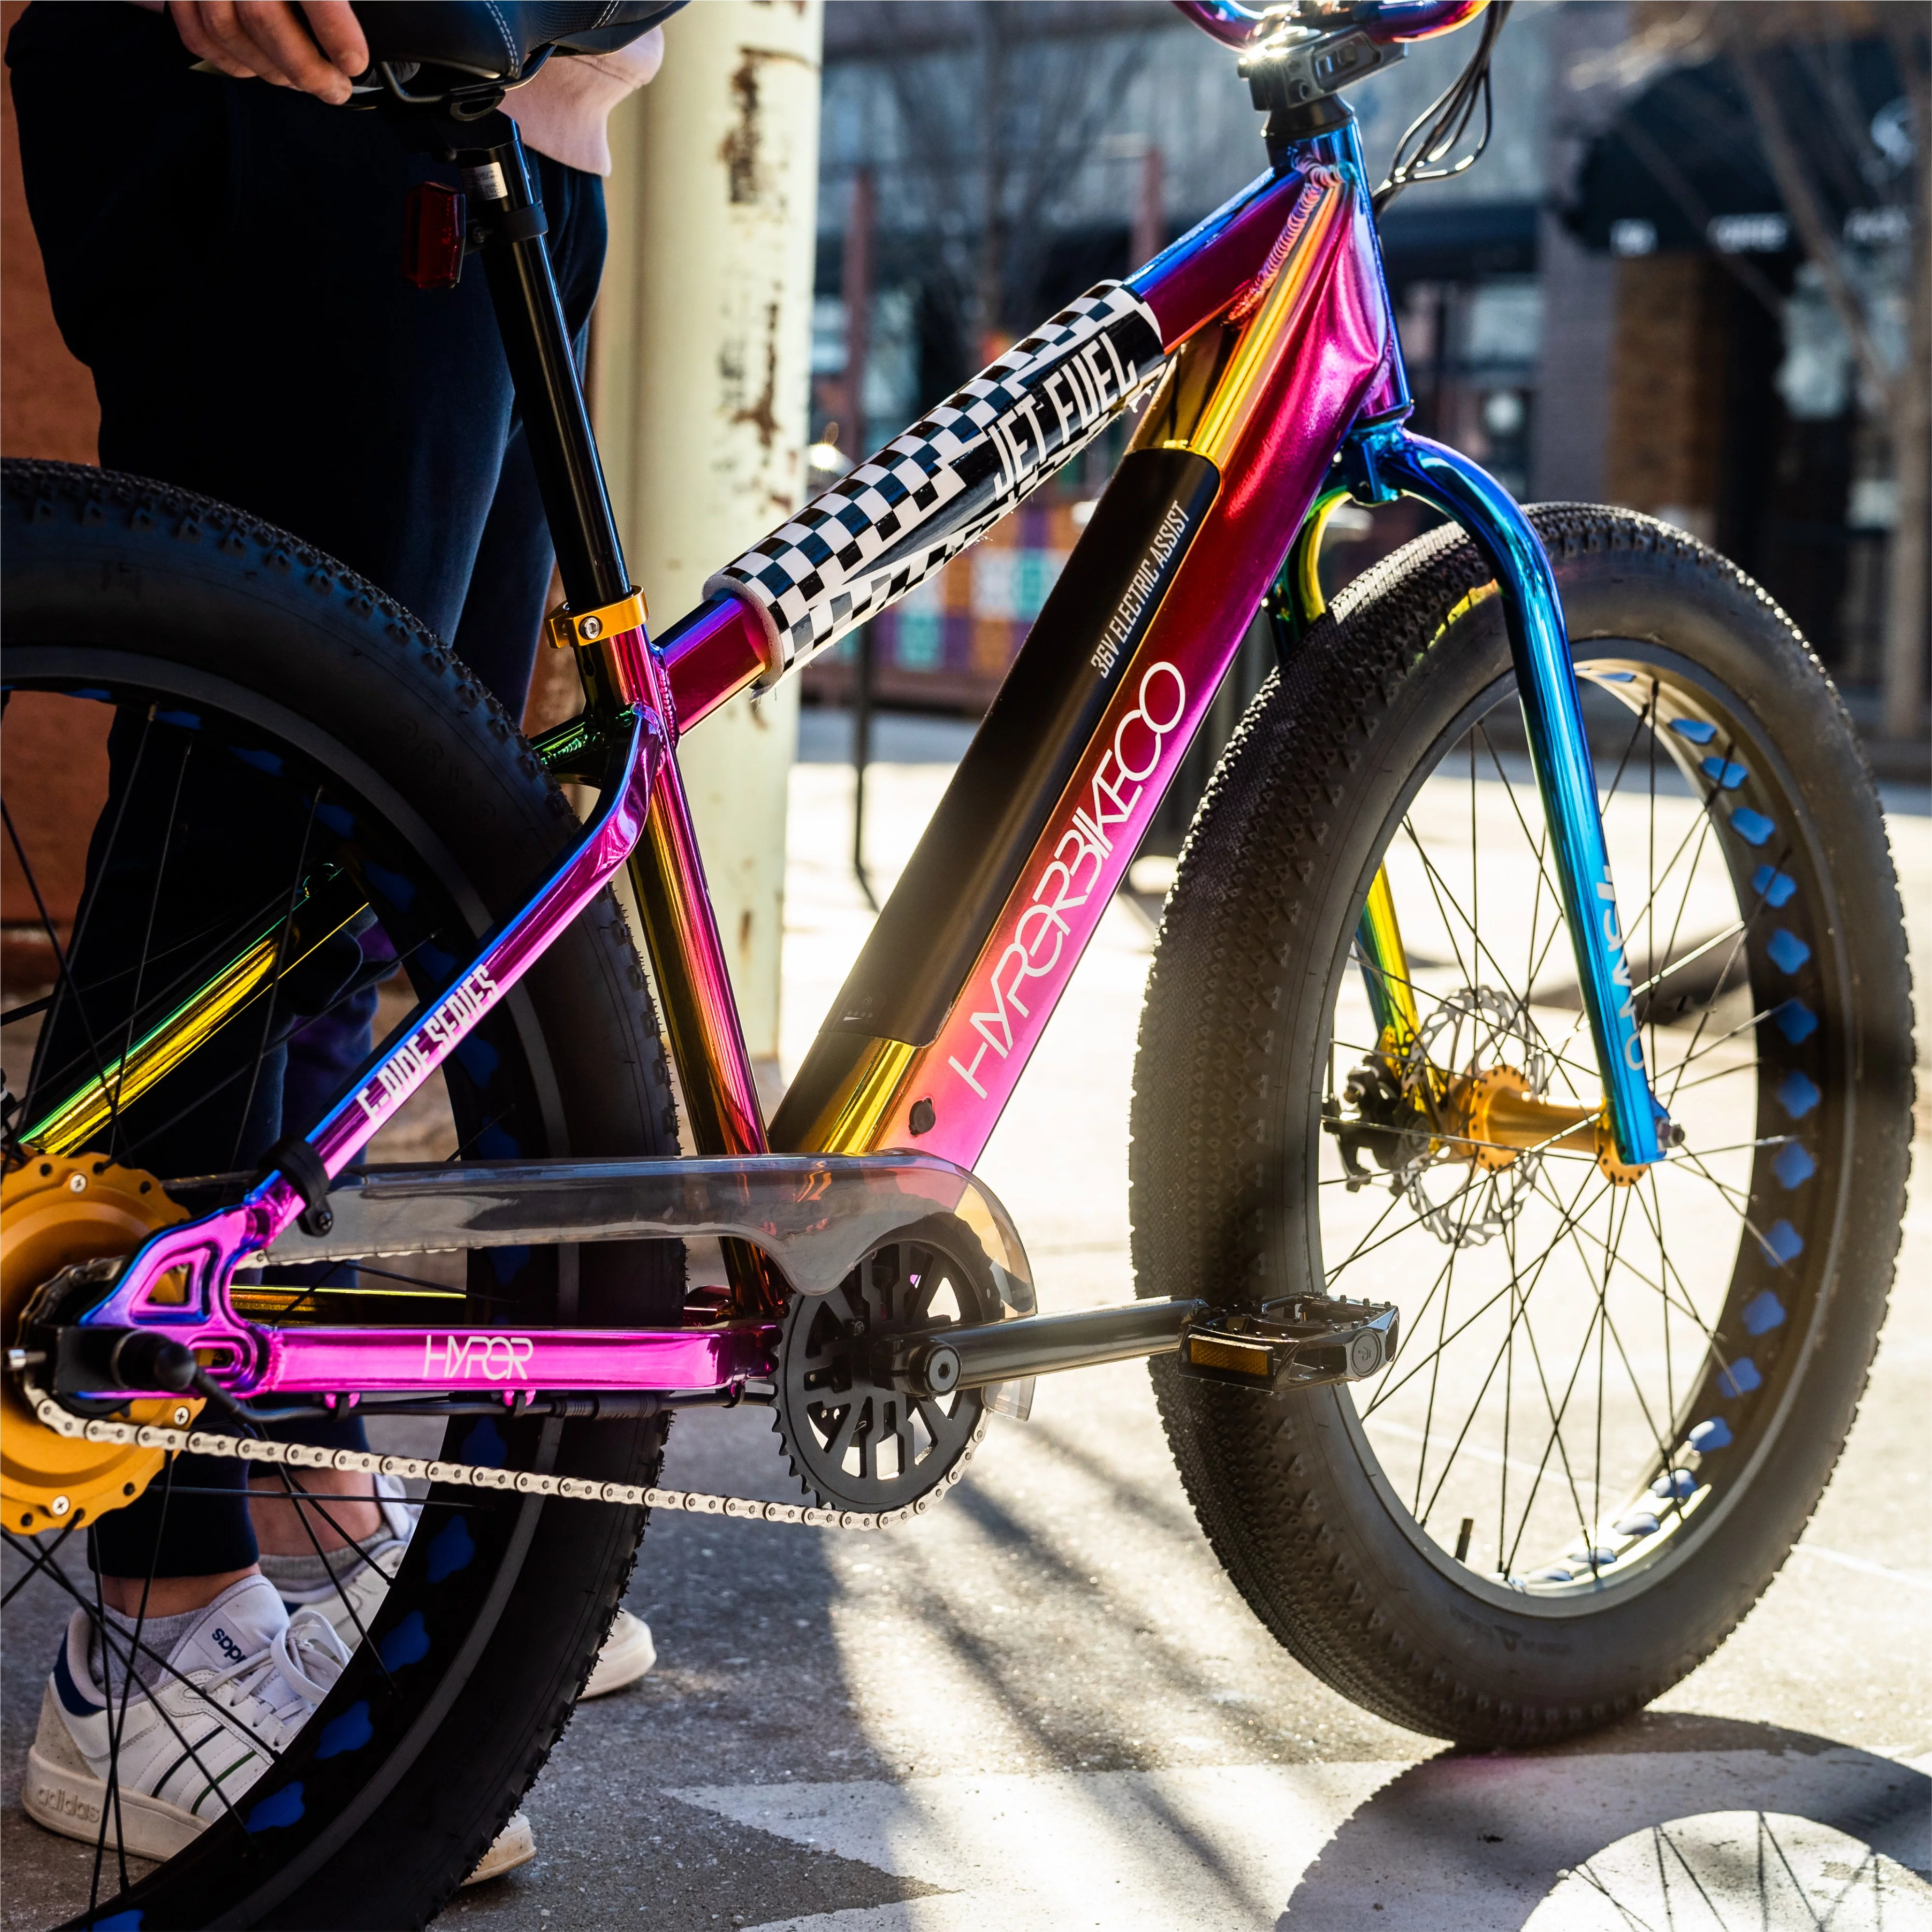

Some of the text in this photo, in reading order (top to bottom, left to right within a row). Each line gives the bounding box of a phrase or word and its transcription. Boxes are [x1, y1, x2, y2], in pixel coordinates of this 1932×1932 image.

[988, 332, 1138, 501] JET FUEL
[1090, 500, 1189, 678] 36V ELECTRIC ASSIST
[356, 963, 500, 1127] E-RIDE SERIES
[423, 1335, 534, 1380] HYPER
[38, 1788, 99, 1823] adidas
